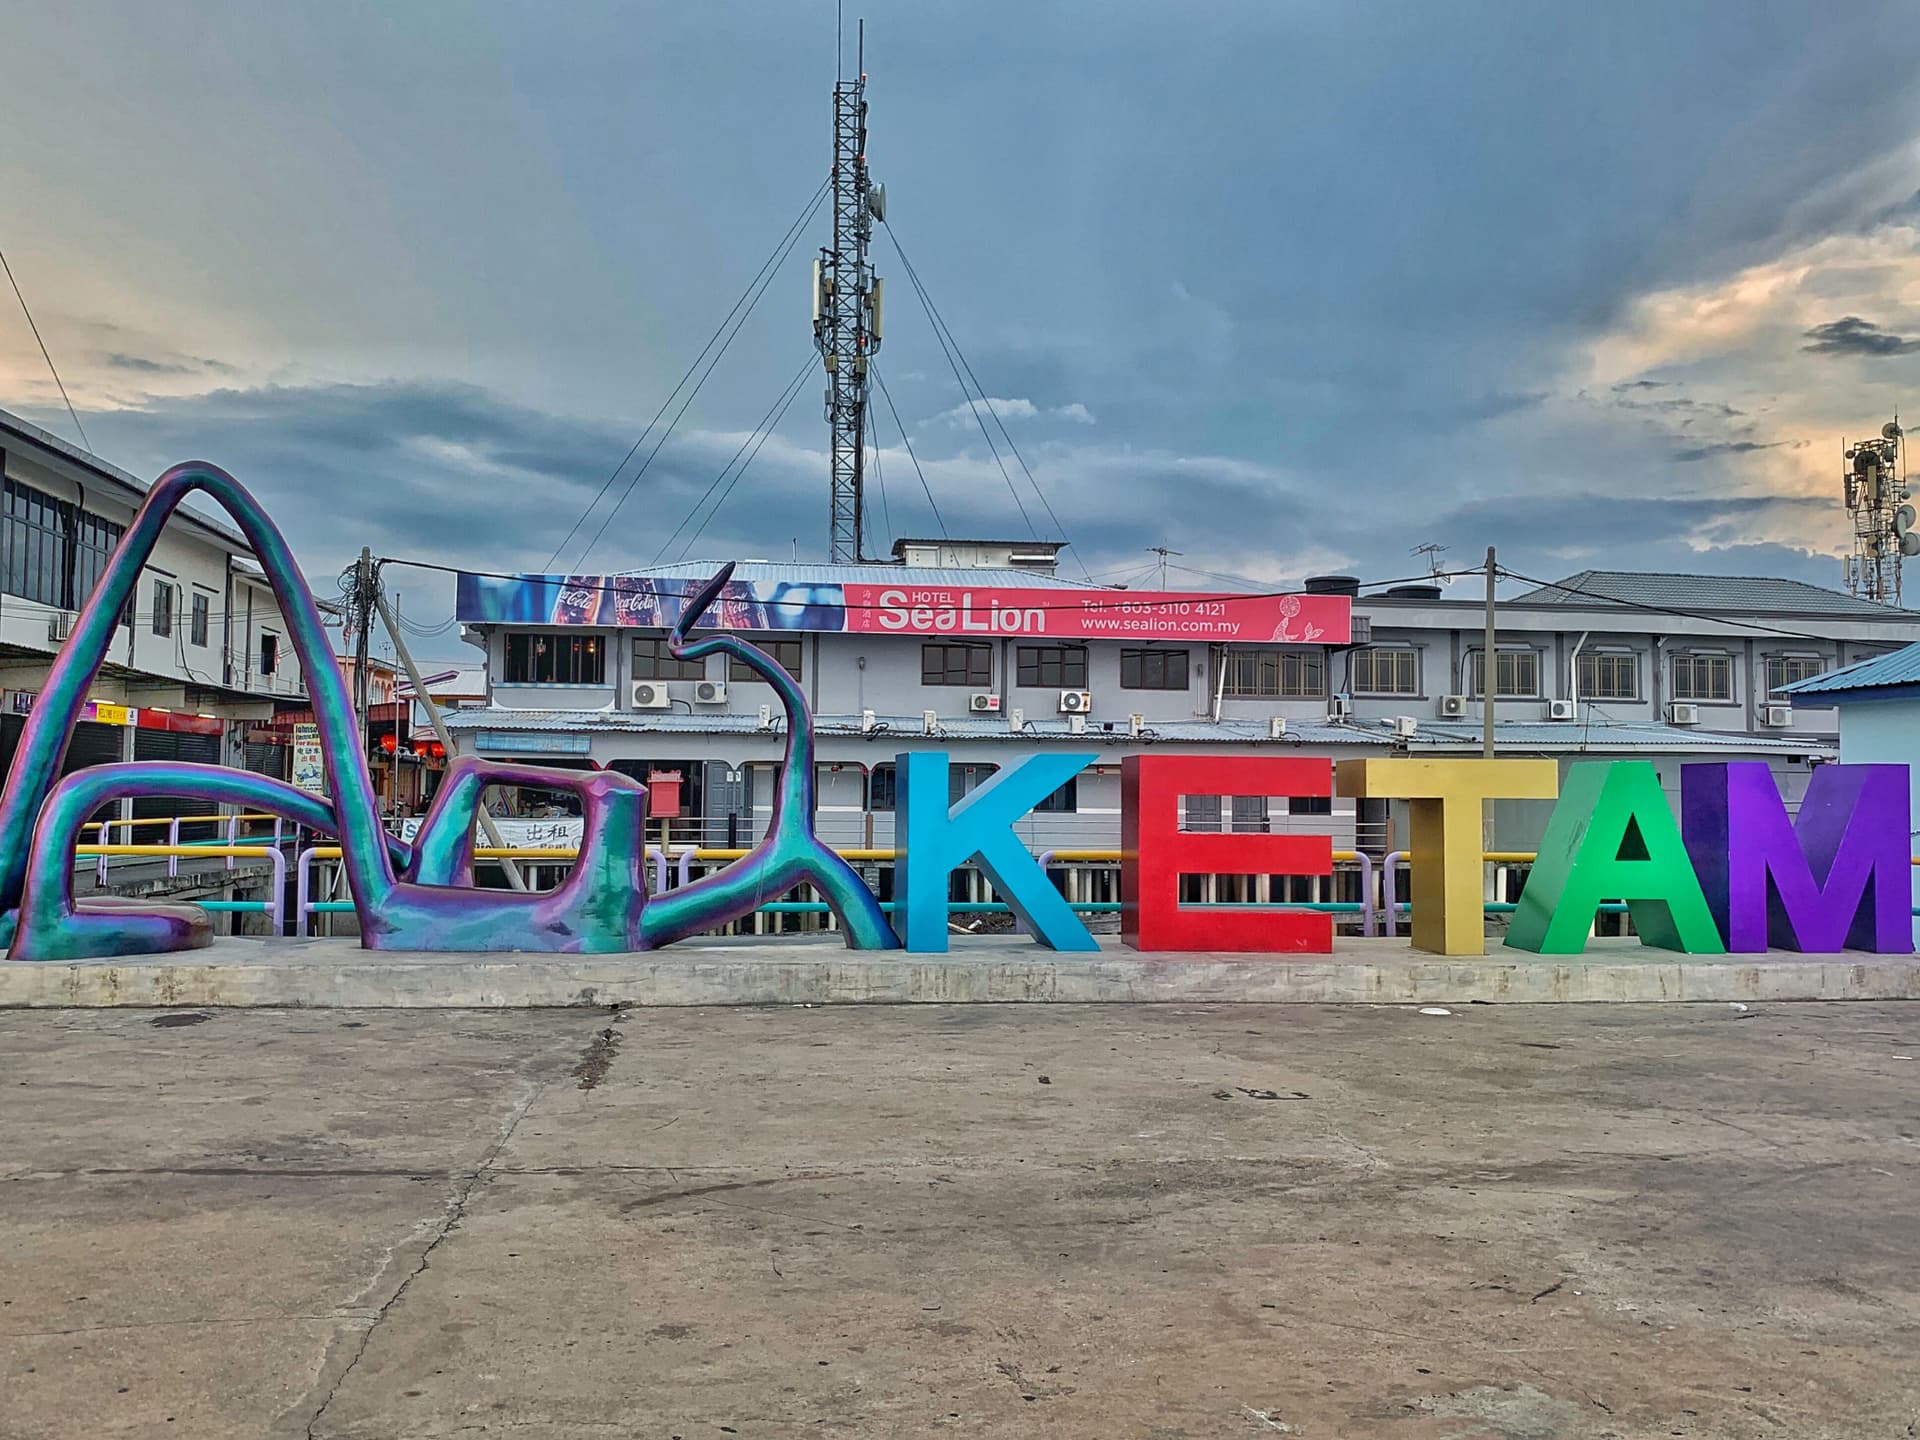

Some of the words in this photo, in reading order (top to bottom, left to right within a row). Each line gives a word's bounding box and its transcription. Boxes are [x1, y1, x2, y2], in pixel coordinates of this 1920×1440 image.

[912, 591, 955, 603] HOTEL
[1081, 599, 1107, 613] Tel.
[1195, 603, 1226, 616] 4121
[1081, 617, 1241, 635] www.sealion.com.my
[526, 823, 569, 842] 出租
[896, 752, 1912, 956] KETAM
